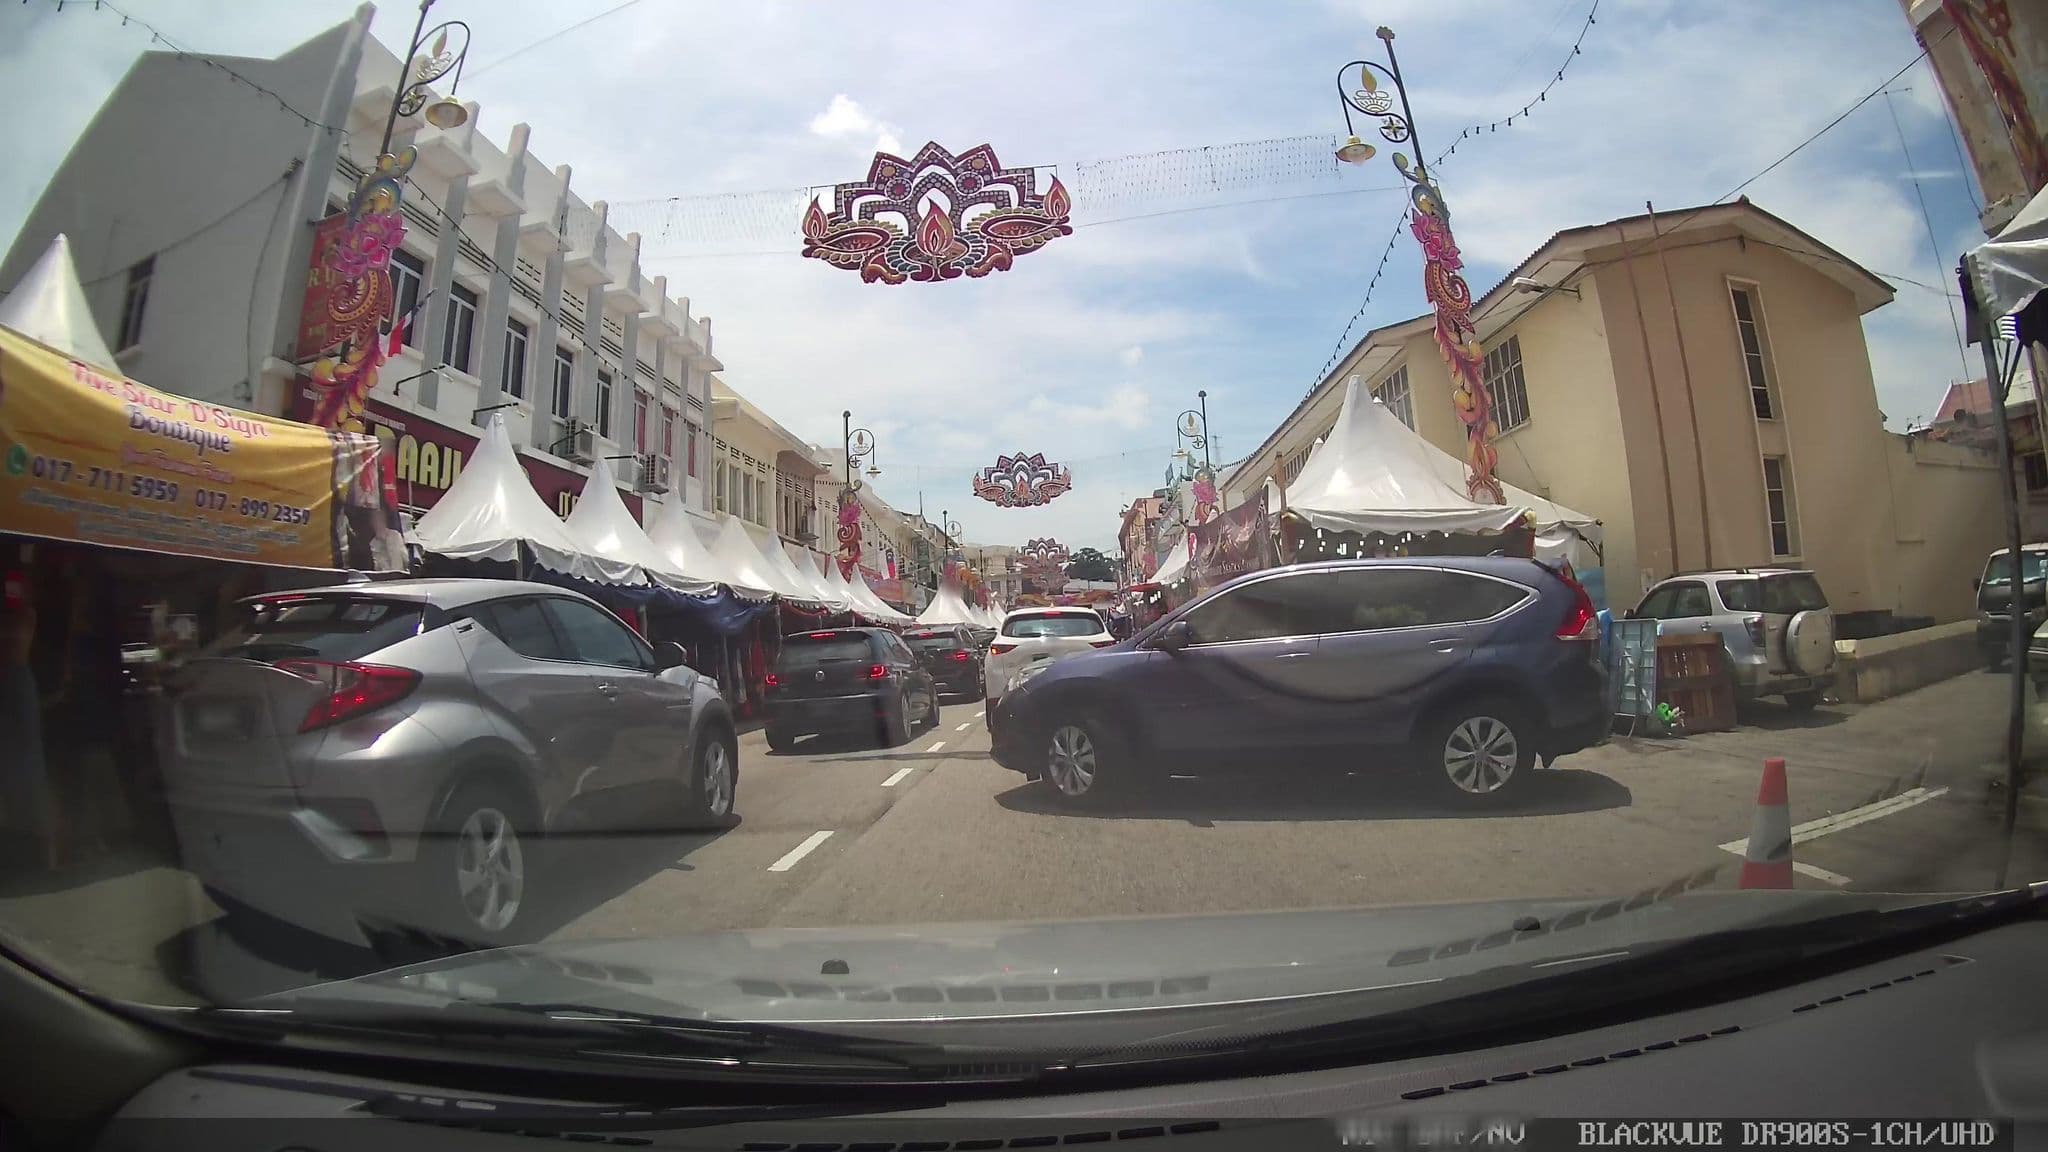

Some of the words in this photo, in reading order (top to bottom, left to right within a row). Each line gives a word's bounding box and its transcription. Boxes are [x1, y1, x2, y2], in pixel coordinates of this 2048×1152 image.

[123, 381, 176, 414] Star
[128, 407, 230, 456] Boutique
[130, 474, 179, 501] 5959
[195, 488, 227, 511] 017
[239, 497, 269, 519] 899
[272, 504, 311, 526] 2359
